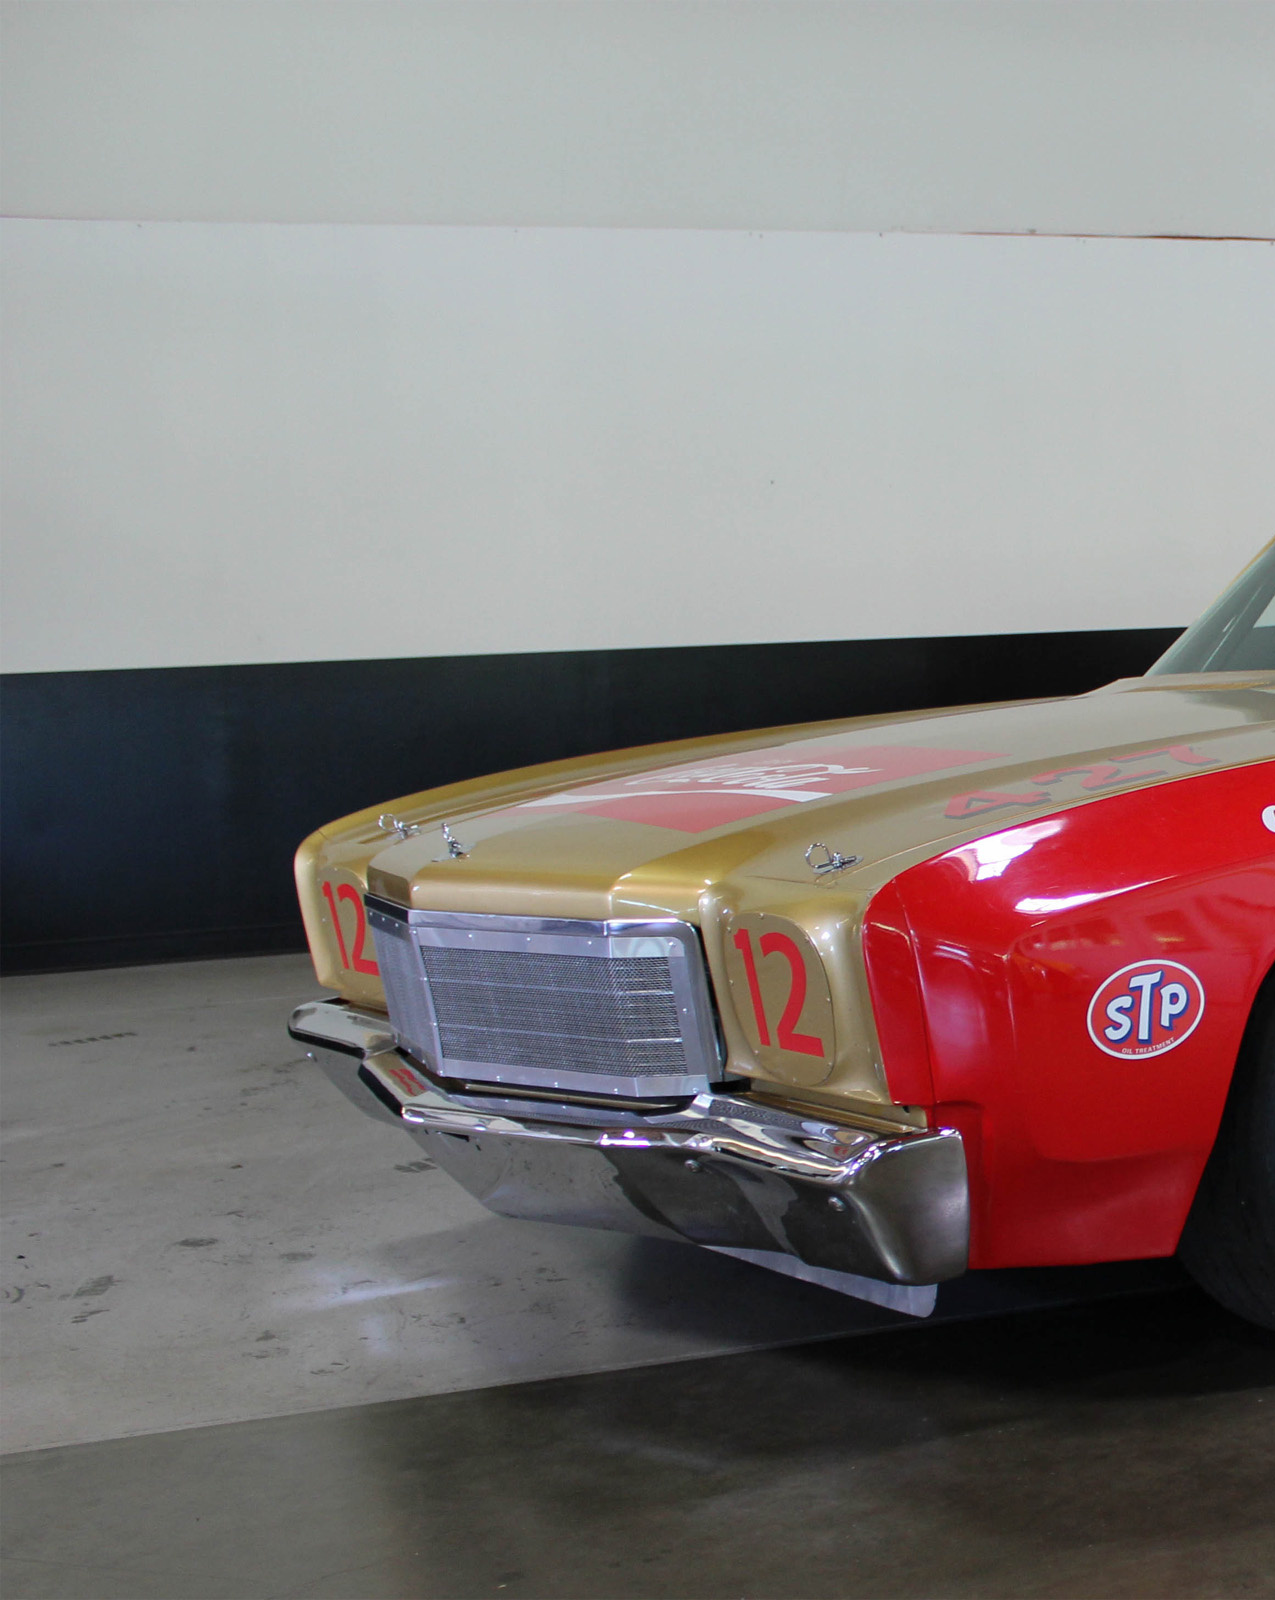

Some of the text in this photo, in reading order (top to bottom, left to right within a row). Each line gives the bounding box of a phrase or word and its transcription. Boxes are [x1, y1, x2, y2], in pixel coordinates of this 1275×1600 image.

[943, 744, 1219, 819] 427
[322, 881, 380, 976] 12
[733, 928, 825, 1058] 12
[1104, 970, 1189, 1044] STP
[1135, 1036, 1175, 1054] TREATMENT
